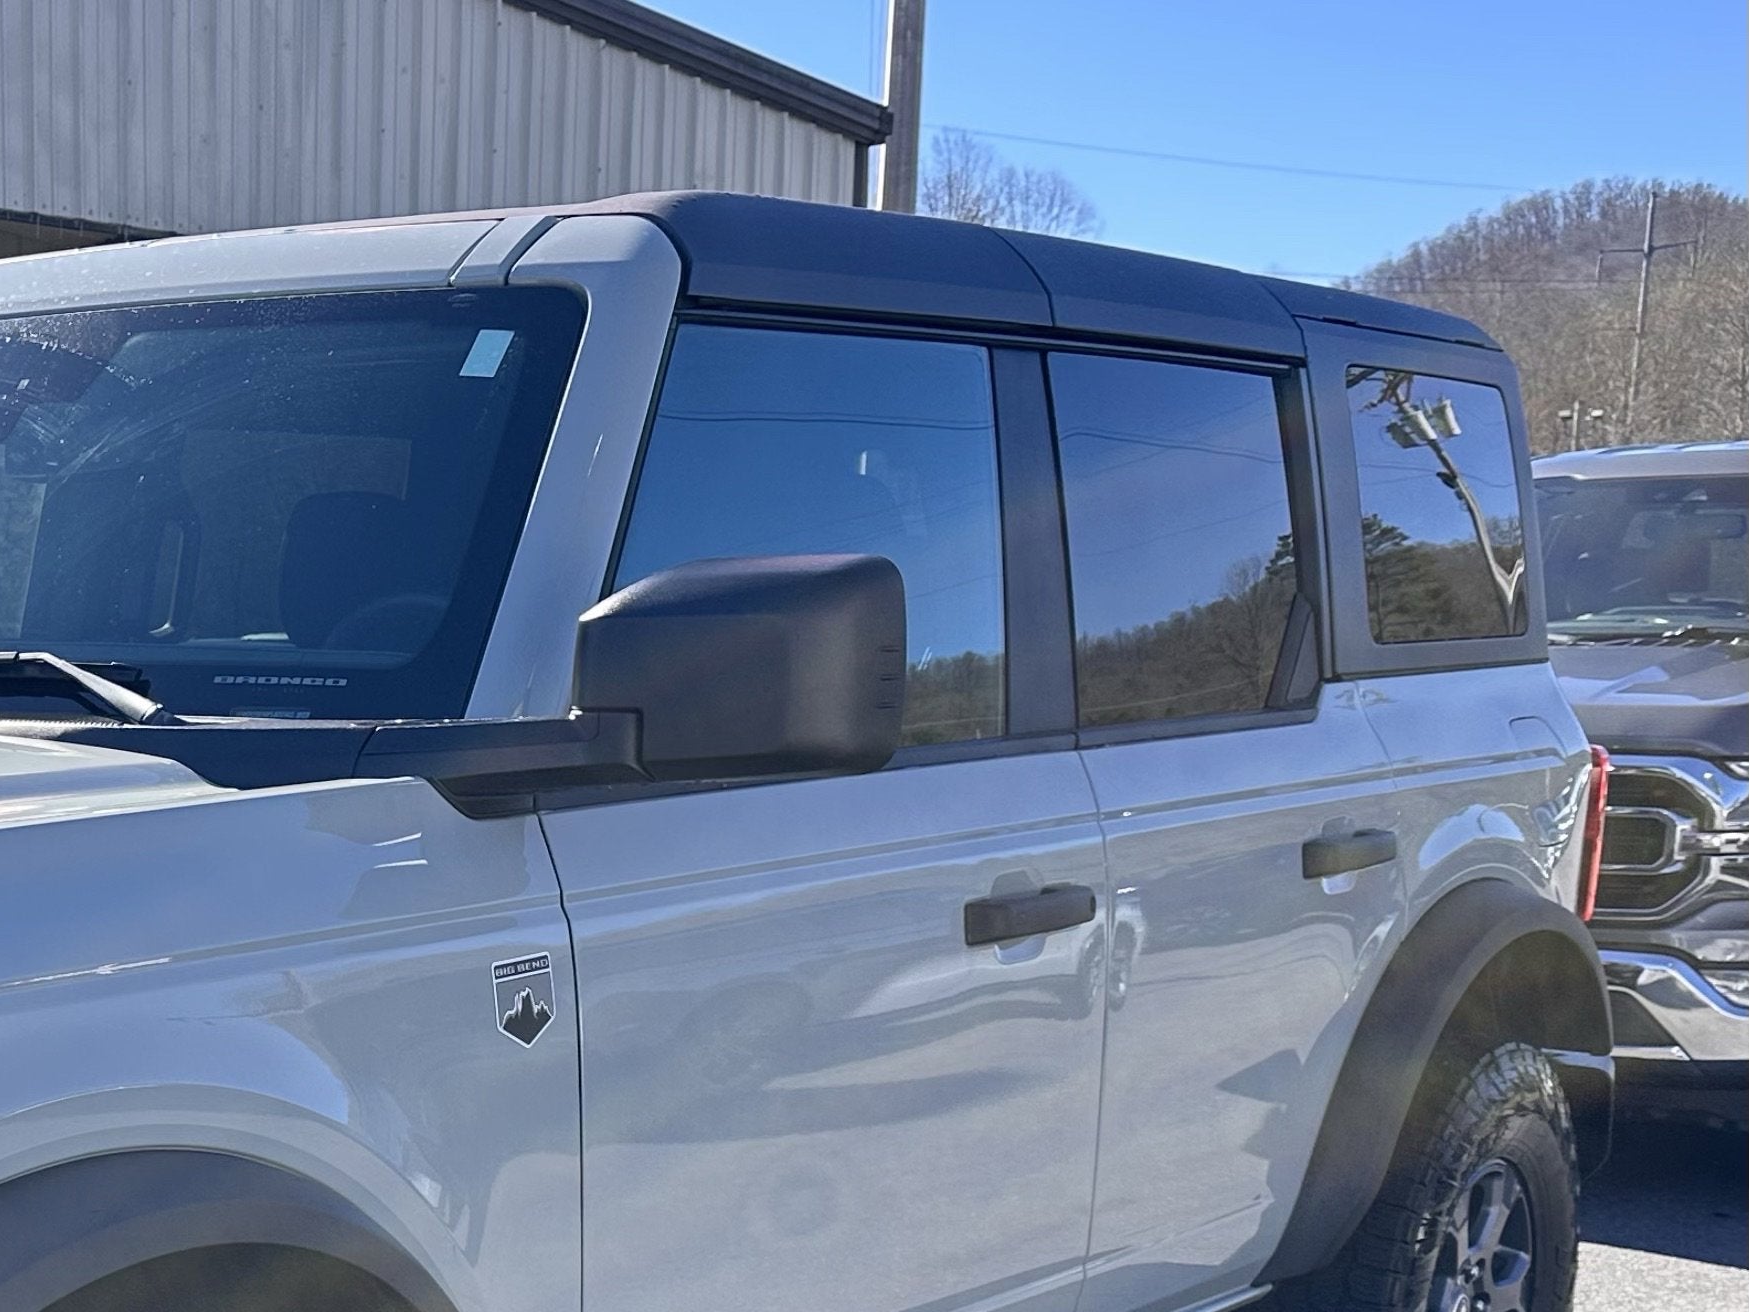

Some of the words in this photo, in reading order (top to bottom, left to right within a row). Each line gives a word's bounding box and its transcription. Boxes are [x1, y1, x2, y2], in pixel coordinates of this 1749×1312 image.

[214, 675, 348, 686] BRONCO
[496, 966, 515, 977] BIG
[518, 959, 548, 972] BEND
